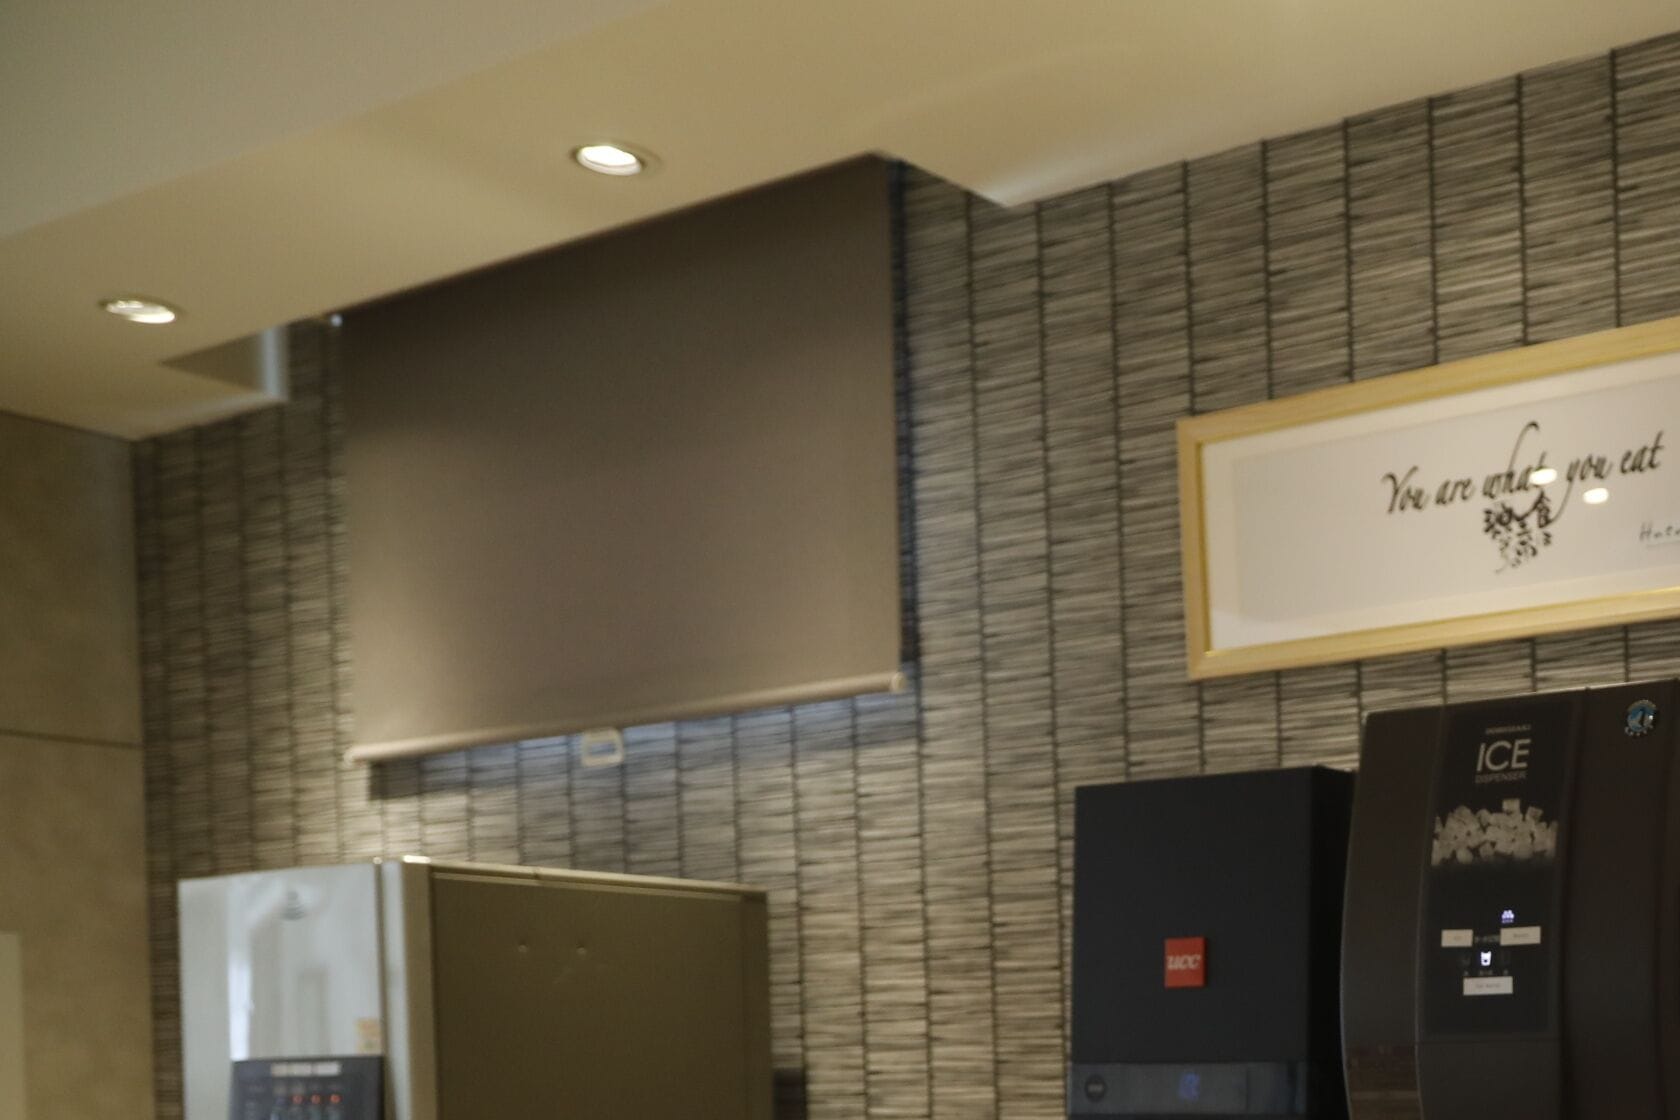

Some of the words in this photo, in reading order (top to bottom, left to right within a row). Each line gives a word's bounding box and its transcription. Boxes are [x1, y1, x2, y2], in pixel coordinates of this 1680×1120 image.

[1382, 466, 1425, 513] You
[1435, 478, 1472, 505] are
[1482, 420, 1556, 500] what
[1620, 430, 1665, 474] eat
[1476, 739, 1532, 772] ICE
